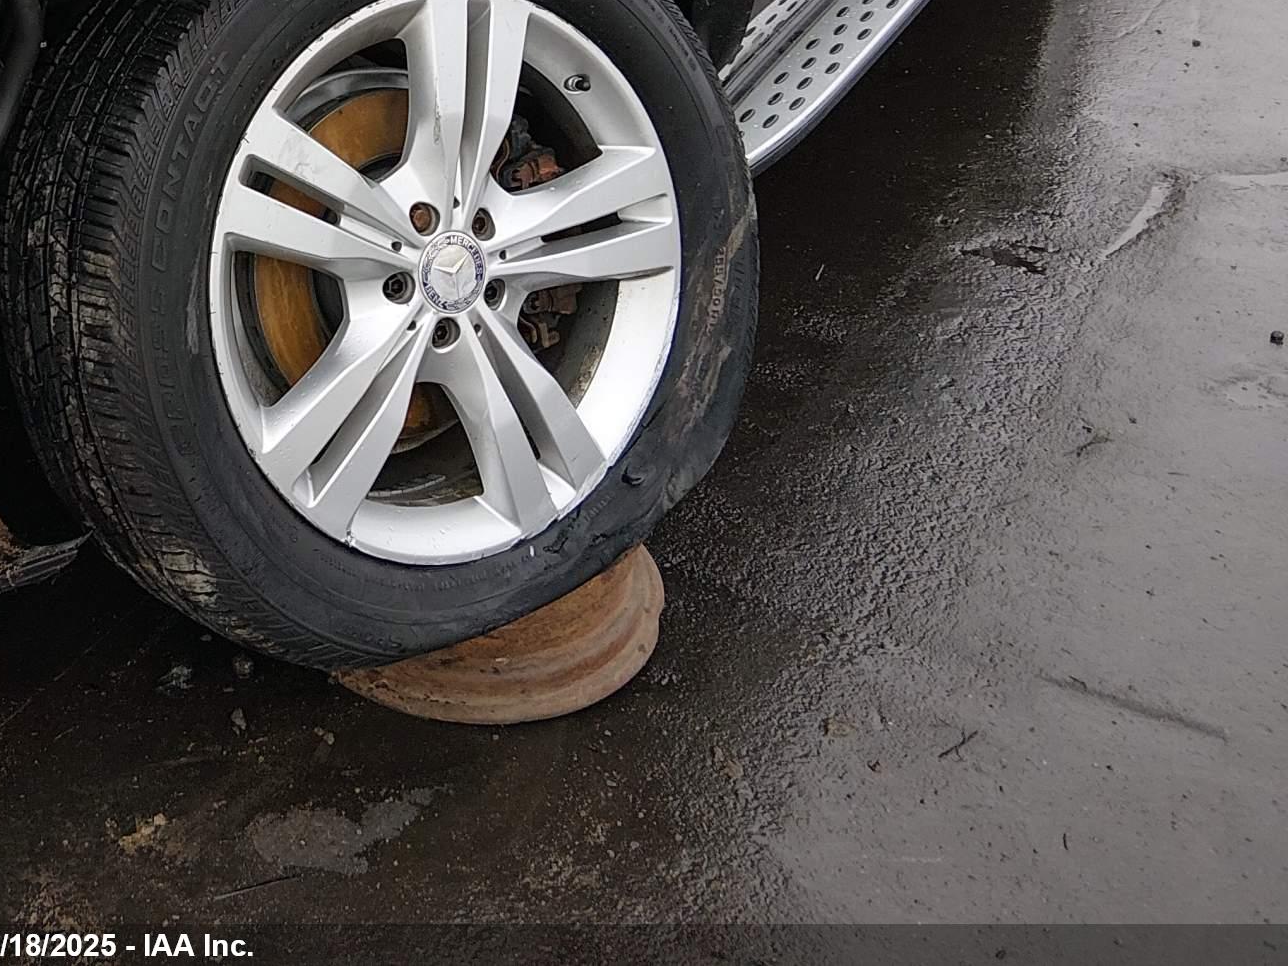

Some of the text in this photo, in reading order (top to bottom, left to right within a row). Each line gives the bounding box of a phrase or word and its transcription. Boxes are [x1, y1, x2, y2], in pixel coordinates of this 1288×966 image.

[151, 50, 231, 274] CONTACT
[450, 235, 483, 275] MERCEDES
[424, 284, 449, 311] BENZ
